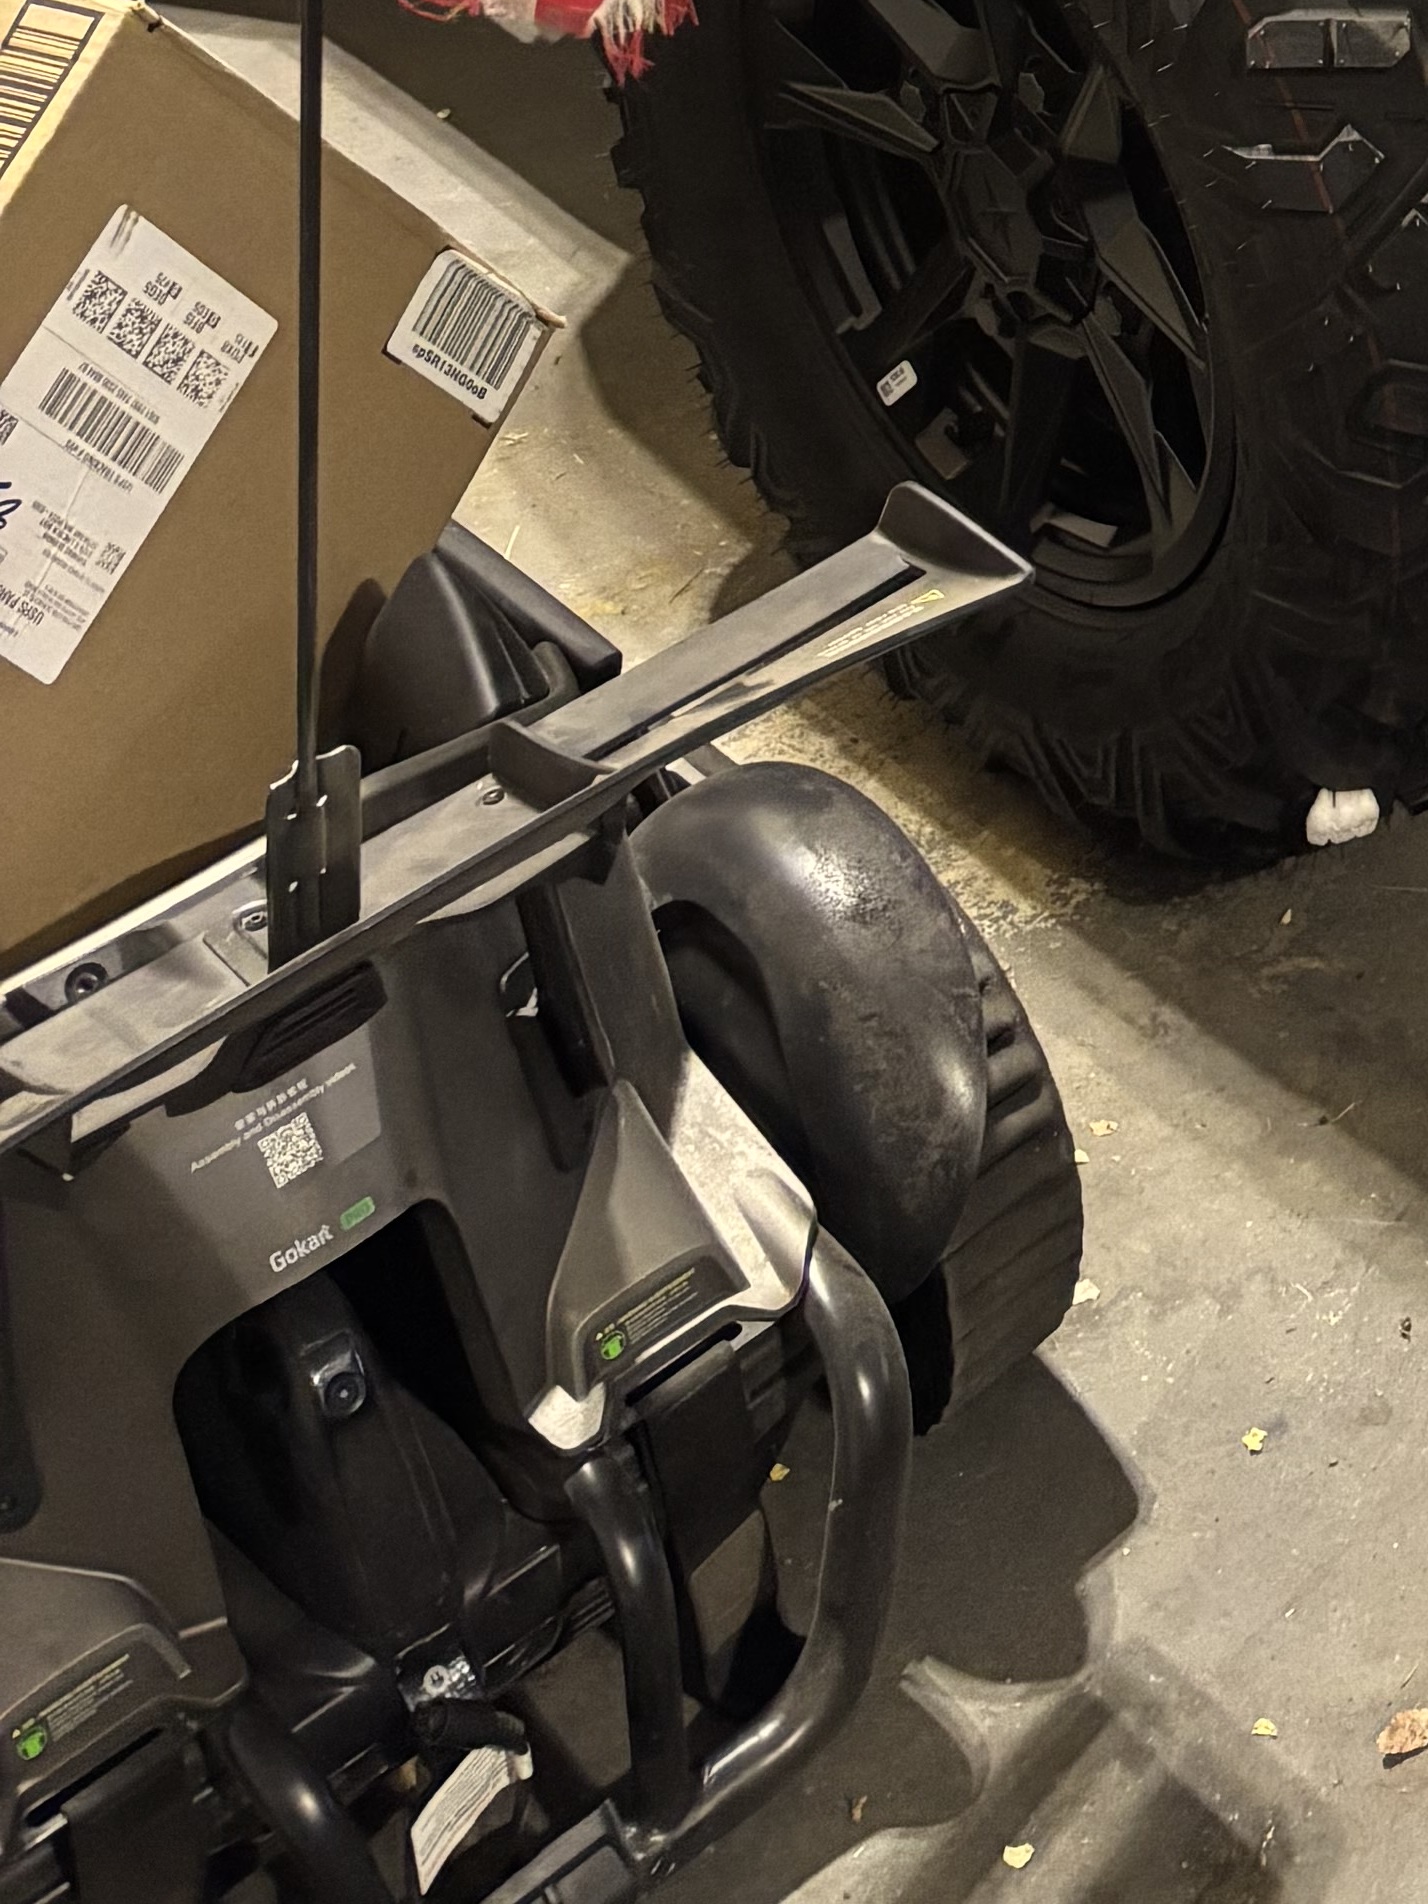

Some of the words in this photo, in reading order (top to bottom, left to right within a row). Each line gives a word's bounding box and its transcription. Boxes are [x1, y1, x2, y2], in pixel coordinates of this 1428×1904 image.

[190, 1136, 241, 1174] Assembly
[242, 1122, 263, 1139] and
[267, 1224, 335, 1273] Gokart
